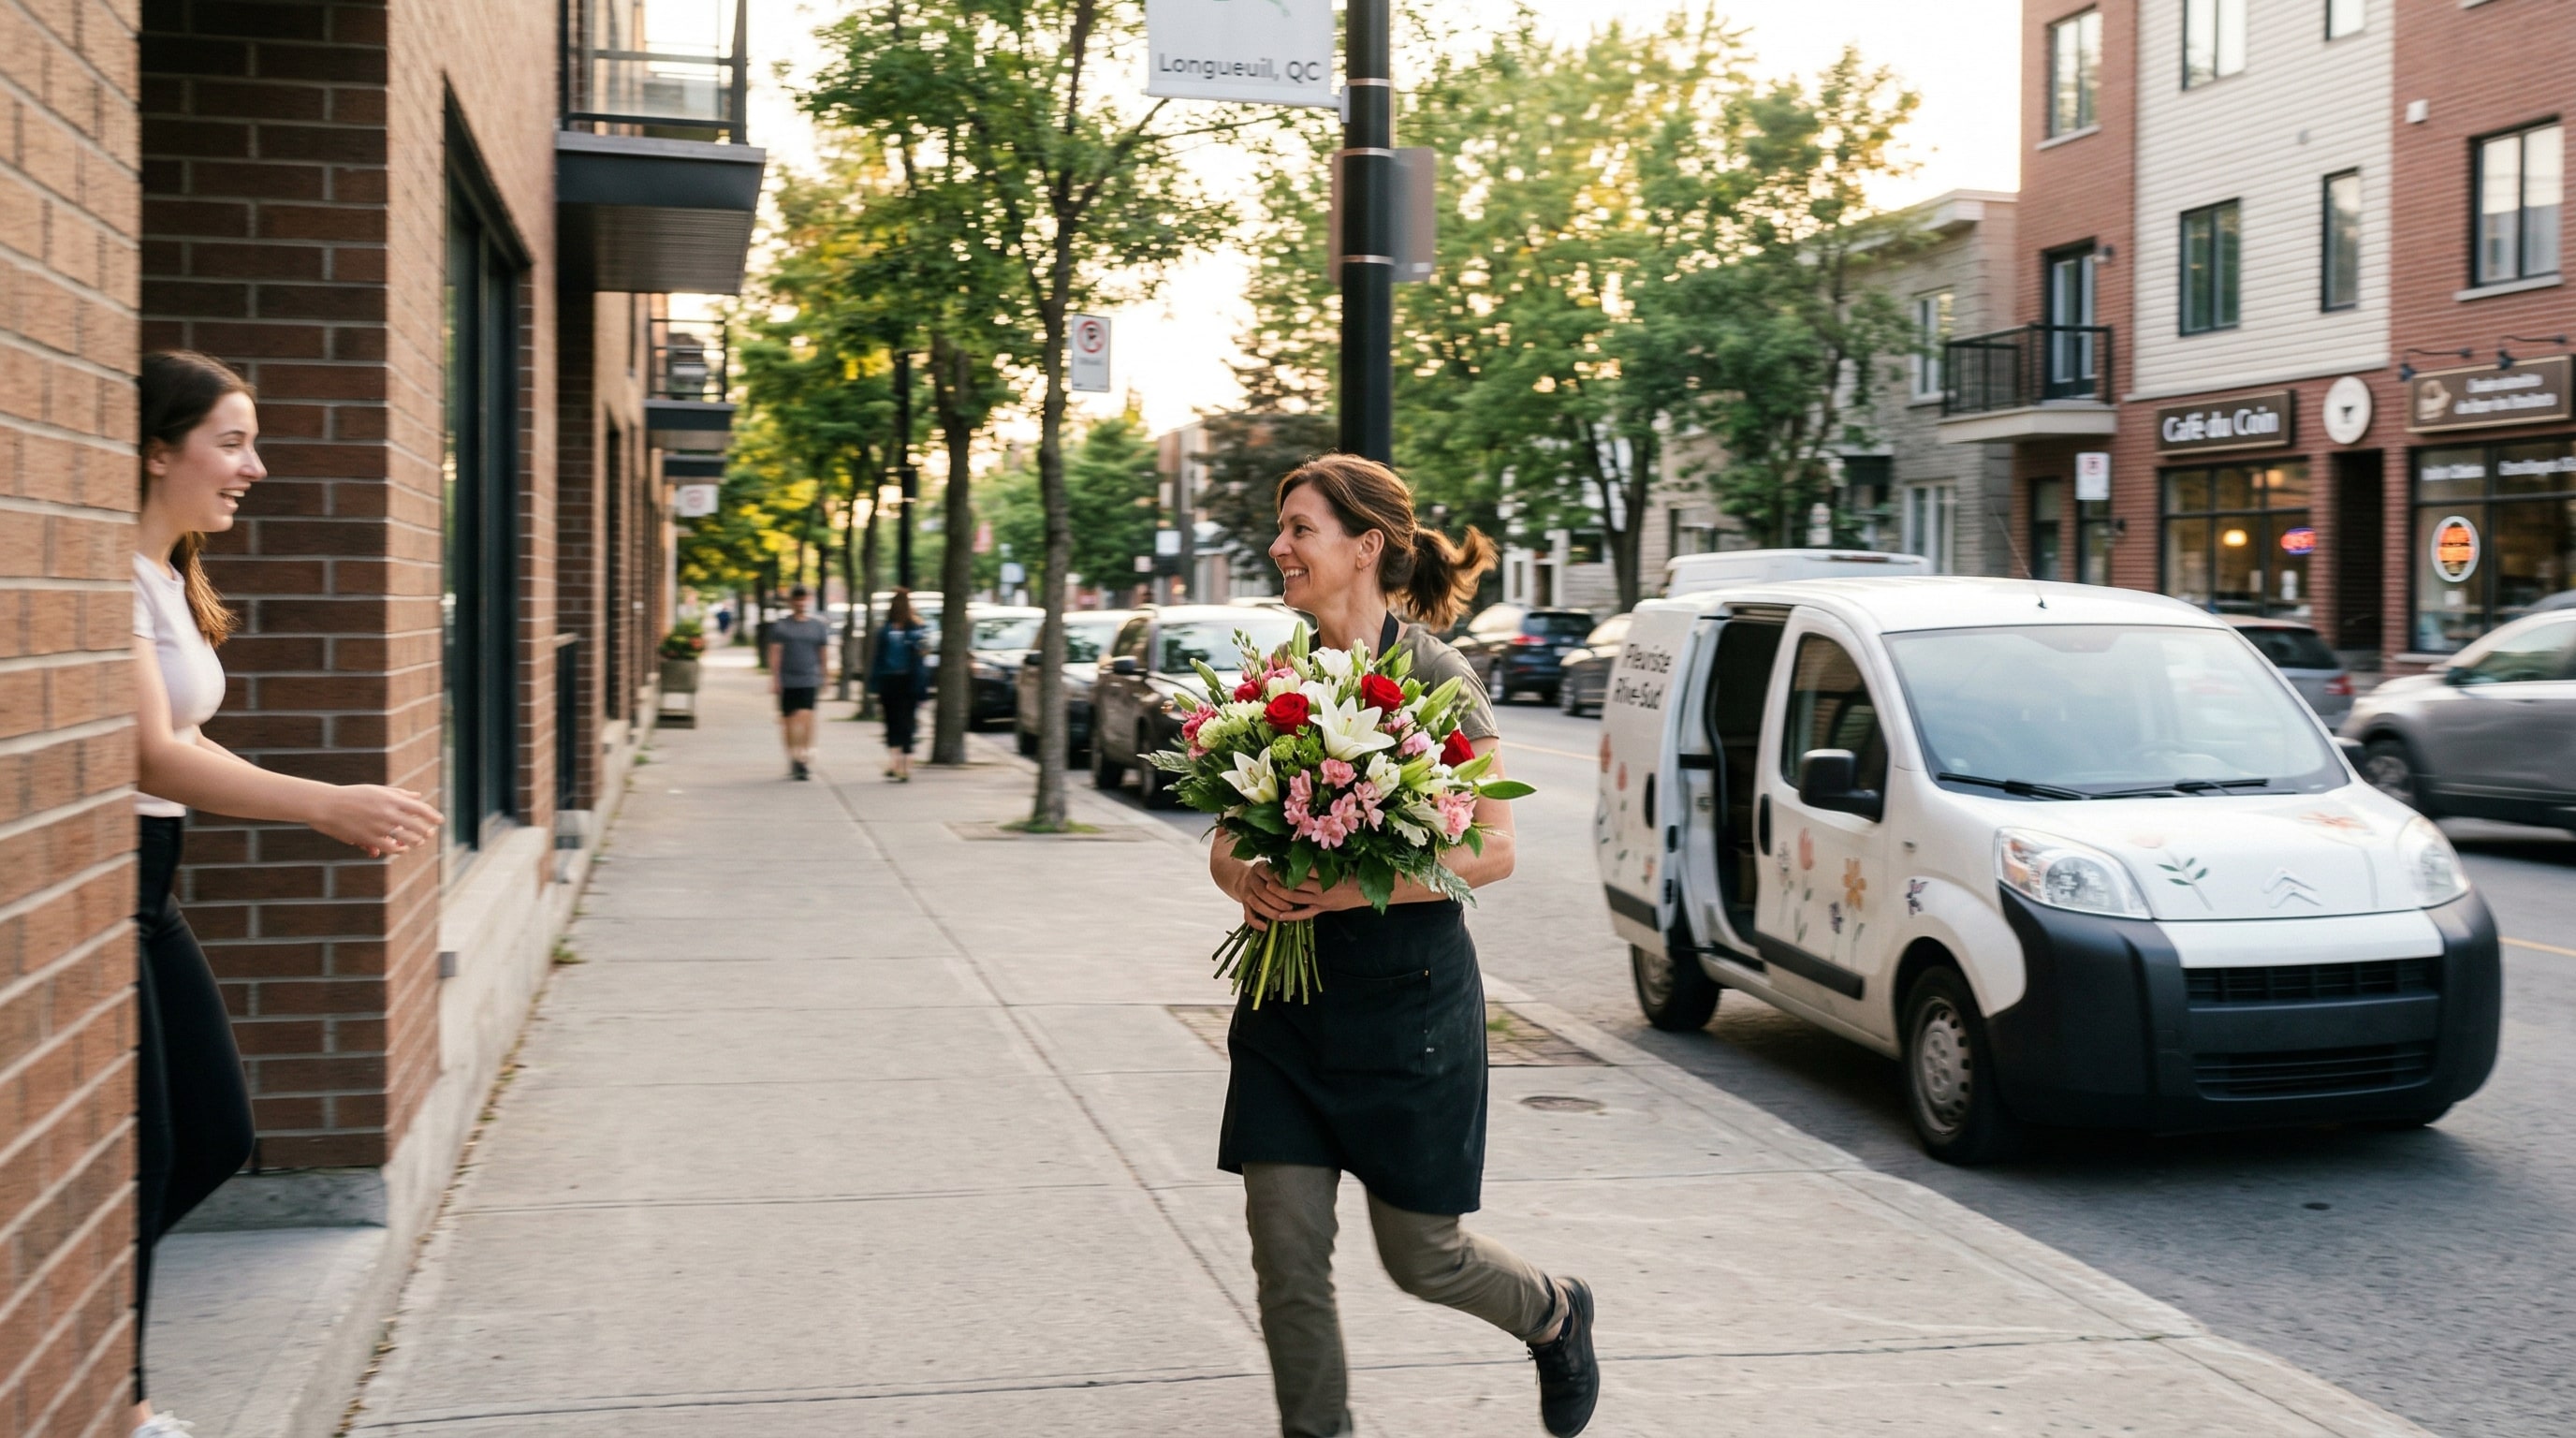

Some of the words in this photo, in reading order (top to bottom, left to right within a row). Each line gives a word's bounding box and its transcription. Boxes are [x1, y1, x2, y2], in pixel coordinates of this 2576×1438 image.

[1158, 52, 1280, 81] Longueuil,
[1286, 60, 1322, 83] QC
[2162, 412, 2205, 443] Café
